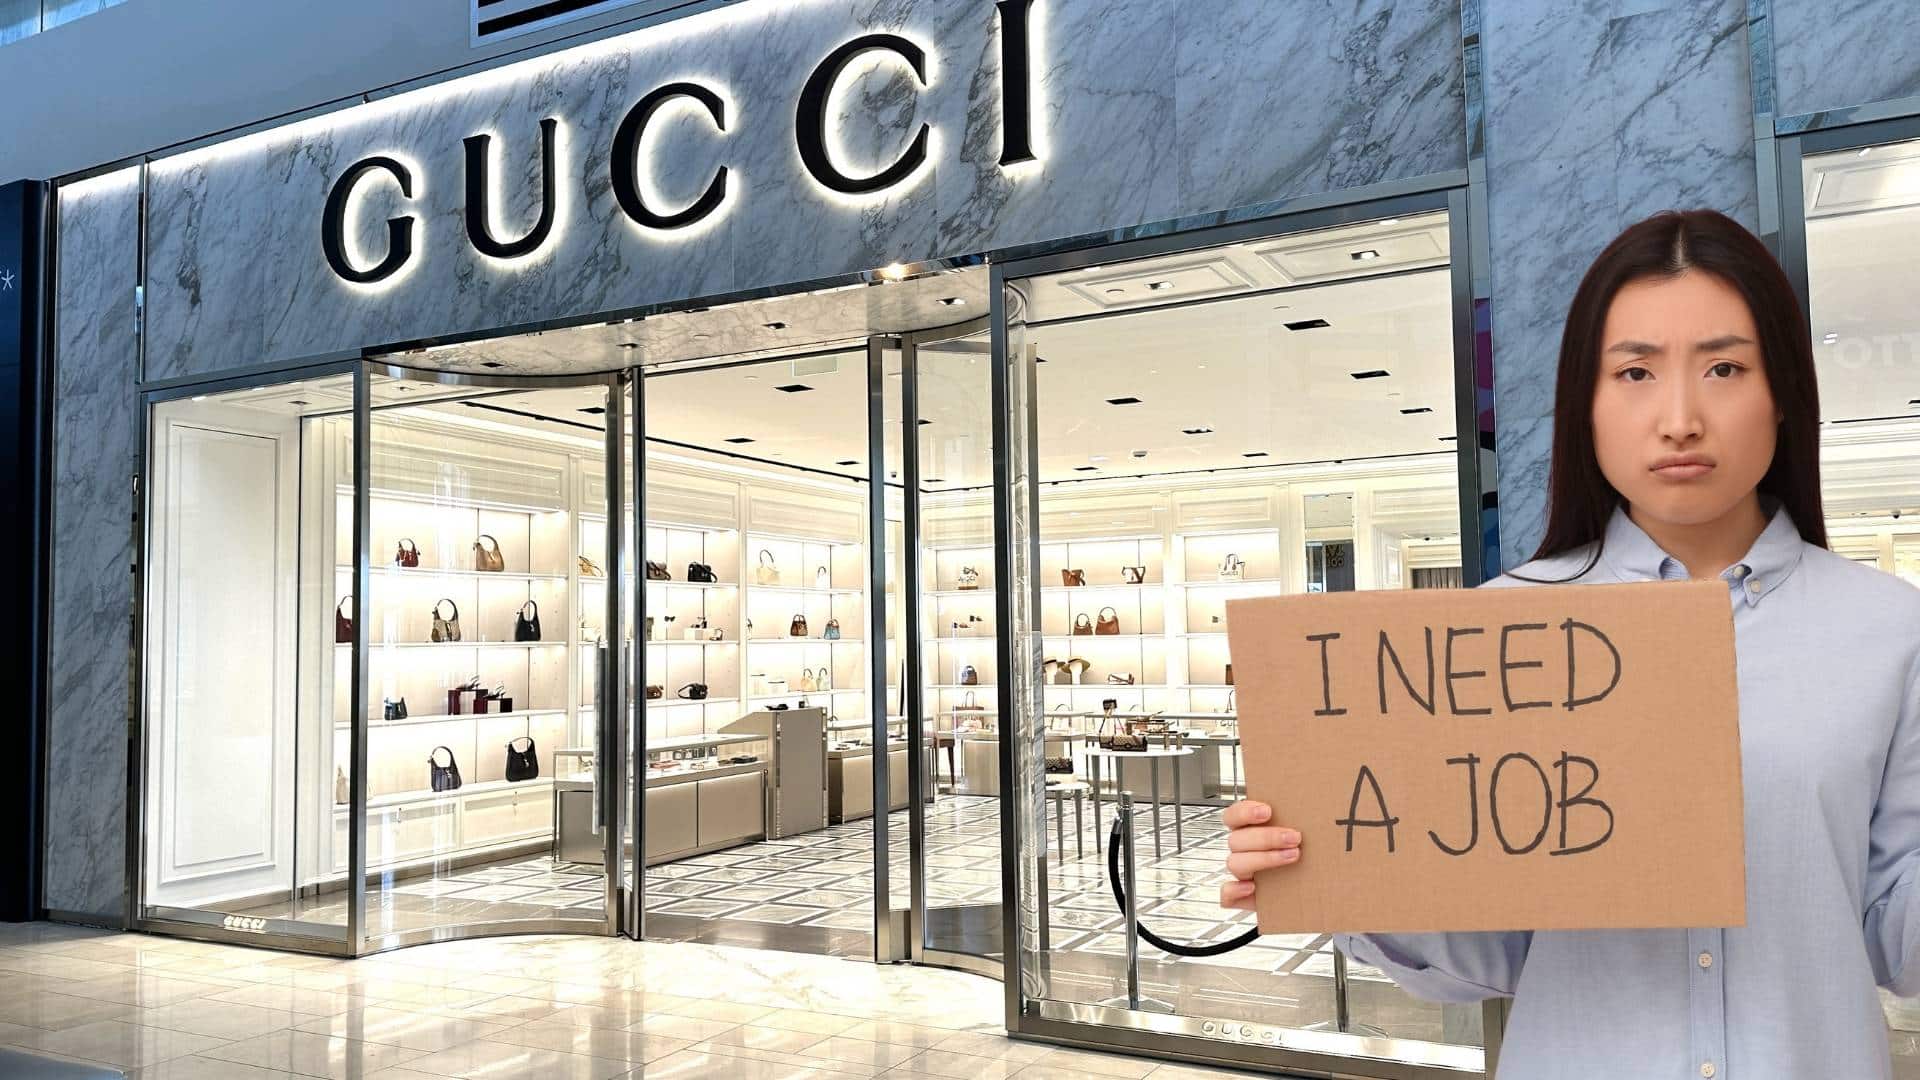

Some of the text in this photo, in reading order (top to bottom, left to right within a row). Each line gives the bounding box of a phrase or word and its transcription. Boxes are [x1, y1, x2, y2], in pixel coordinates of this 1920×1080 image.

[321, 0, 1037, 284] GUCCI
[1306, 617, 1621, 717] I NEED
[1335, 751, 1614, 856] A JOB
